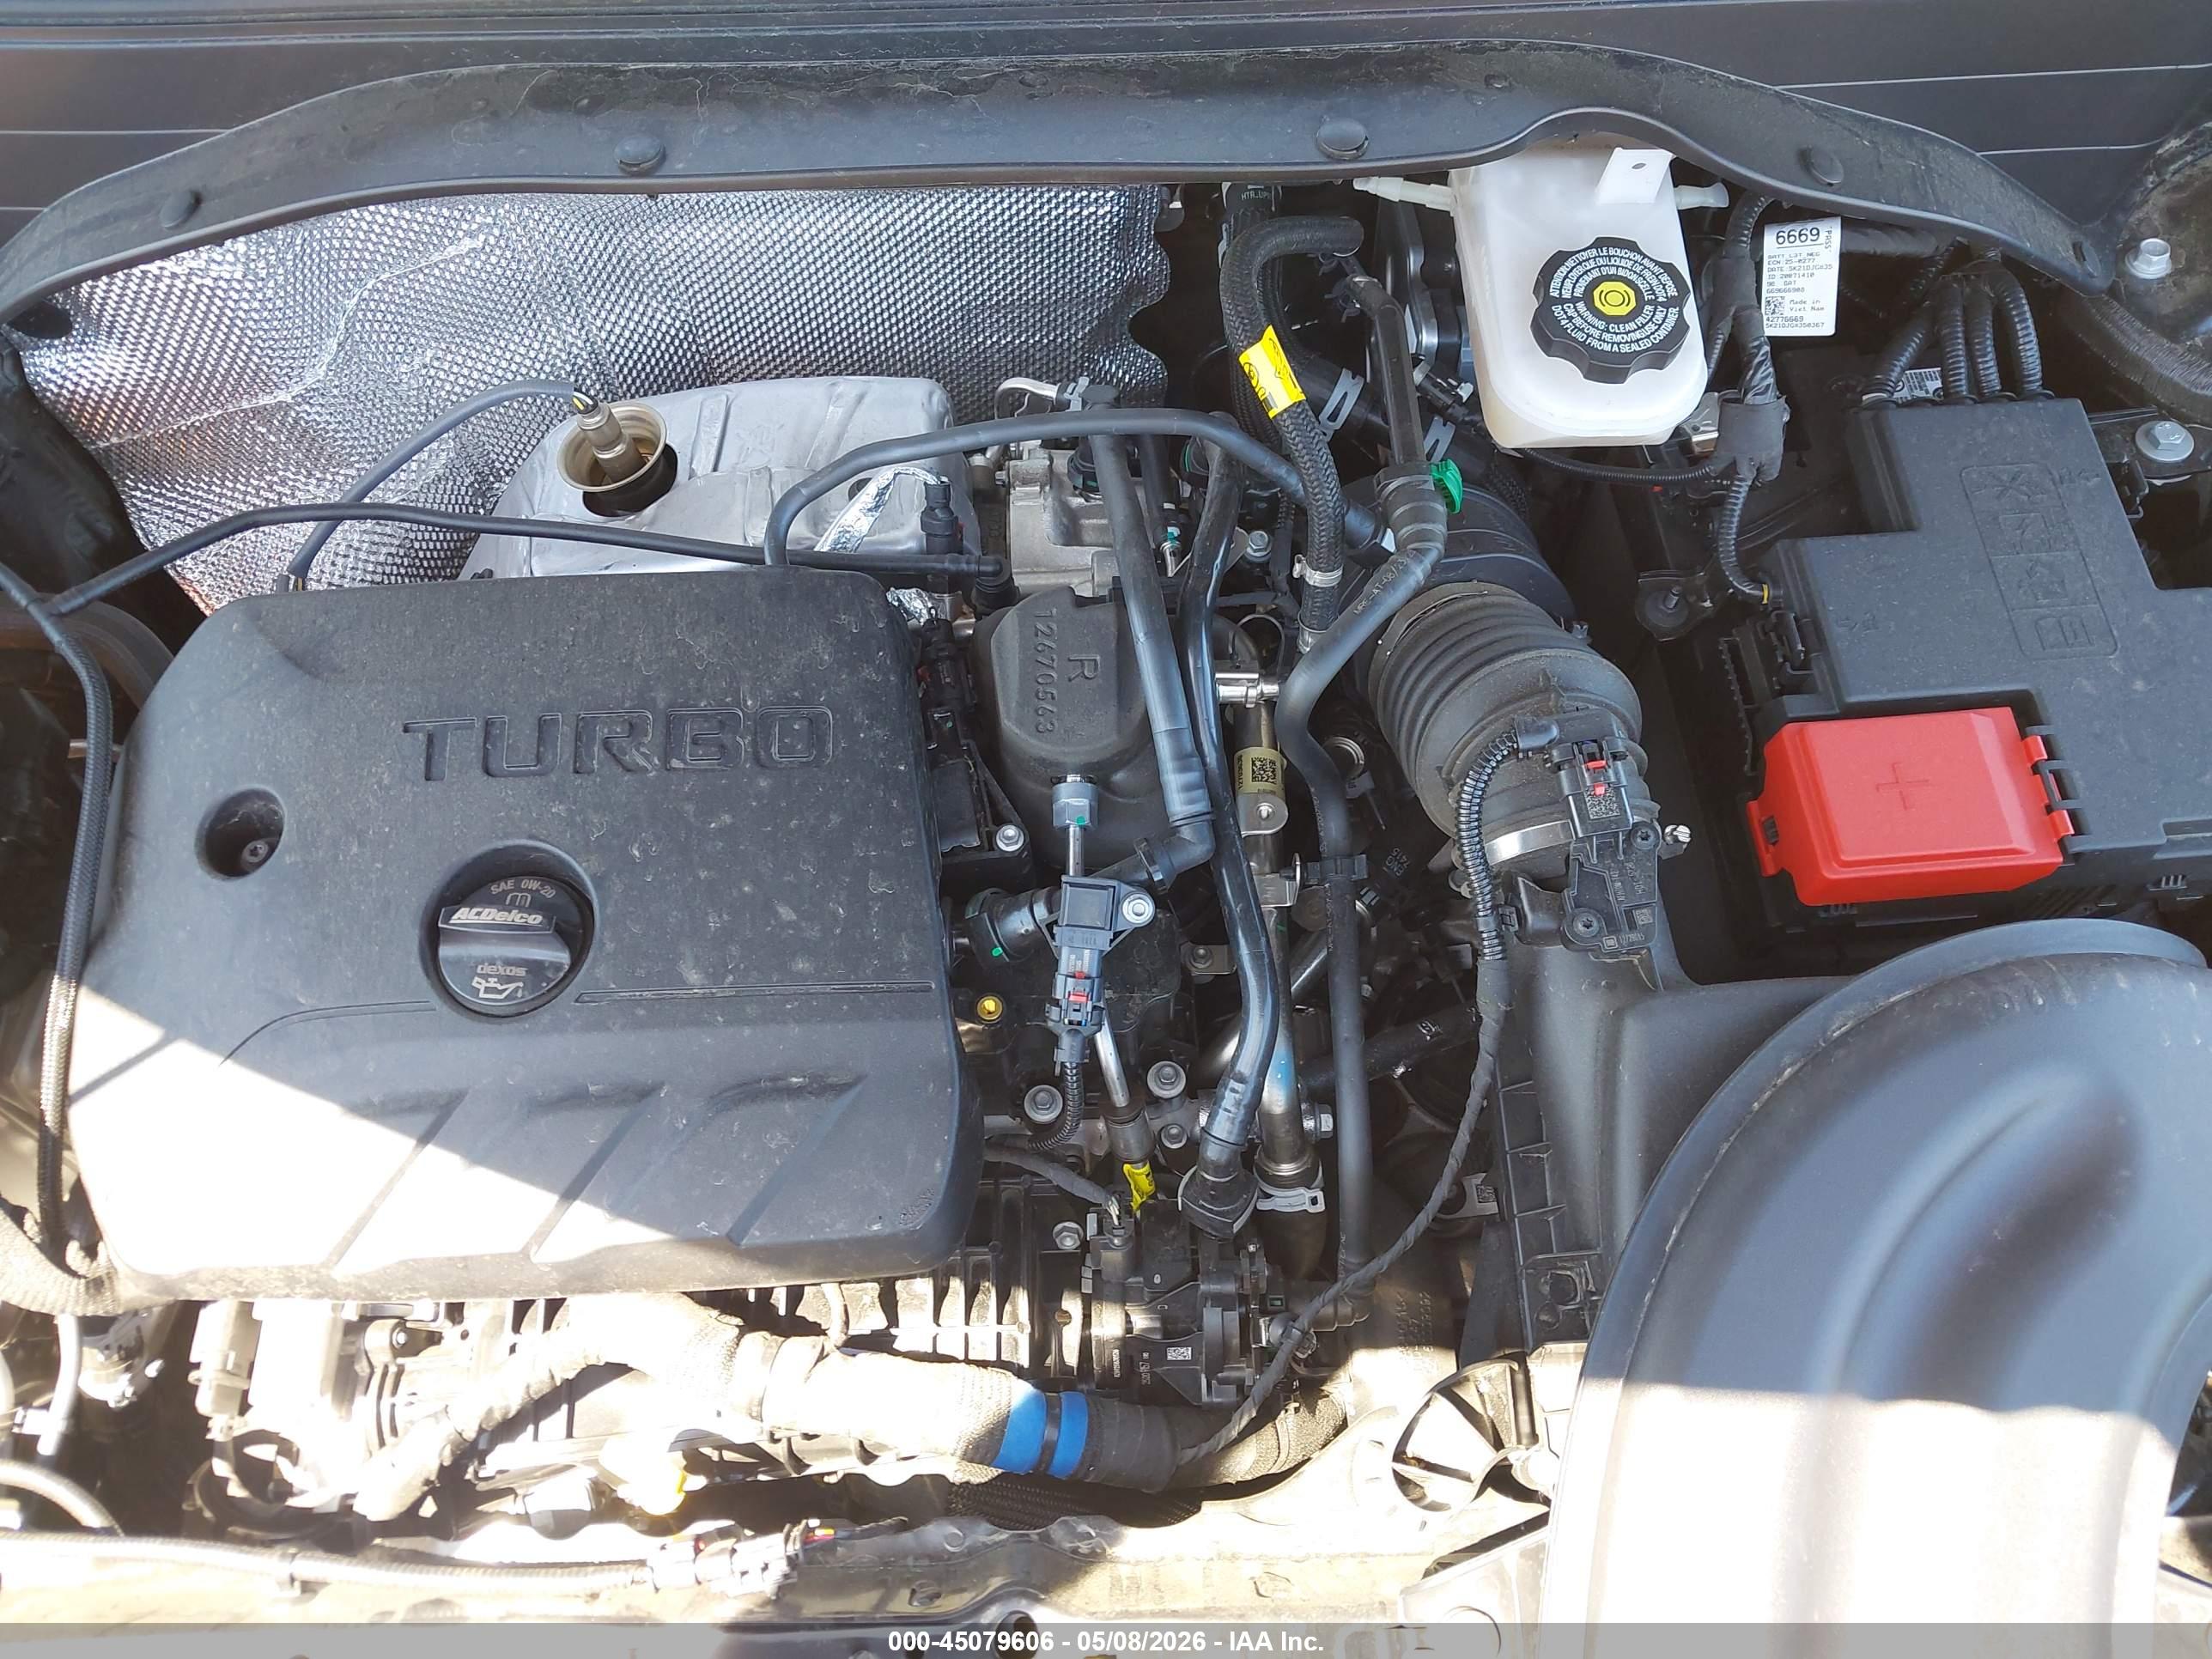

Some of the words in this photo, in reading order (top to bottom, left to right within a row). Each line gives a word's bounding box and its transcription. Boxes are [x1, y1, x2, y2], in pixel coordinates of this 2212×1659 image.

[1776, 227, 1820, 245] 6669
[1595, 257, 1607, 266] DU
[1606, 257, 1635, 269] LIQUIDE
[1632, 263, 1644, 274] DE
[1597, 247, 1608, 256] LE
[1608, 246, 1644, 262] BOUCHON
[1641, 258, 1664, 275] AVANT
[1563, 303, 1578, 318] CAP
[1571, 316, 1602, 338] BEFORE
[1652, 305, 1667, 324] ONLY
[1575, 301, 1608, 331] WARNING:
[1608, 321, 1638, 332] CLEAN
[1634, 305, 1655, 327] FILLER
[1564, 322, 1588, 342] FLUID
[1585, 337, 1612, 352] FROM
[1612, 343, 1620, 353] A
[1619, 338, 1653, 353] SEALED
[1035, 607, 1058, 734] 12670563
[1067, 654, 1101, 683] R
[403, 705, 834, 782] TURBO
[490, 879, 515, 895] SAE
[520, 878, 556, 899] 0W-20
[452, 907, 544, 925] ACDelco
[477, 963, 529, 977] dexos
